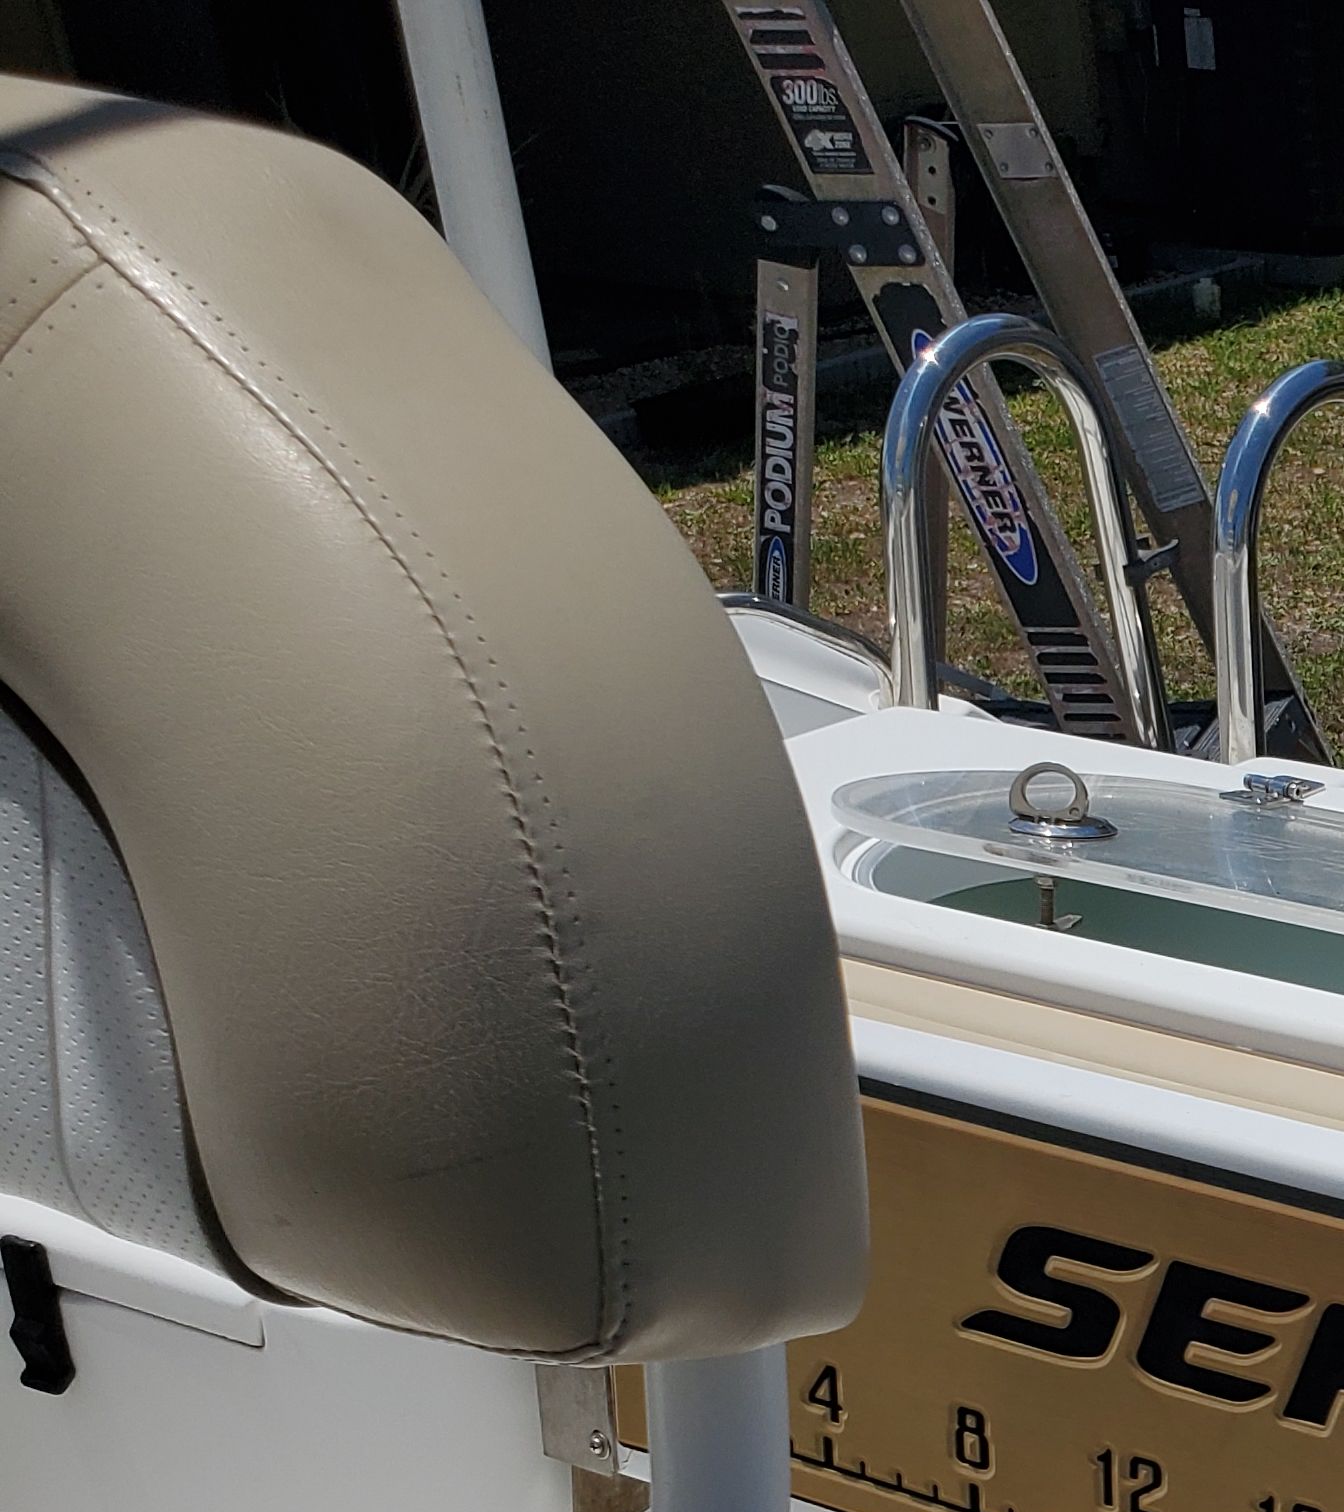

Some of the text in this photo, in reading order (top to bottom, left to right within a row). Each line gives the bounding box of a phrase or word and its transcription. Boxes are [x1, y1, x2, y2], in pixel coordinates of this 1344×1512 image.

[764, 390, 795, 534] PODIUM
[770, 555, 782, 601] ERNER
[807, 1365, 844, 1424] 4
[955, 1406, 992, 1471] 8
